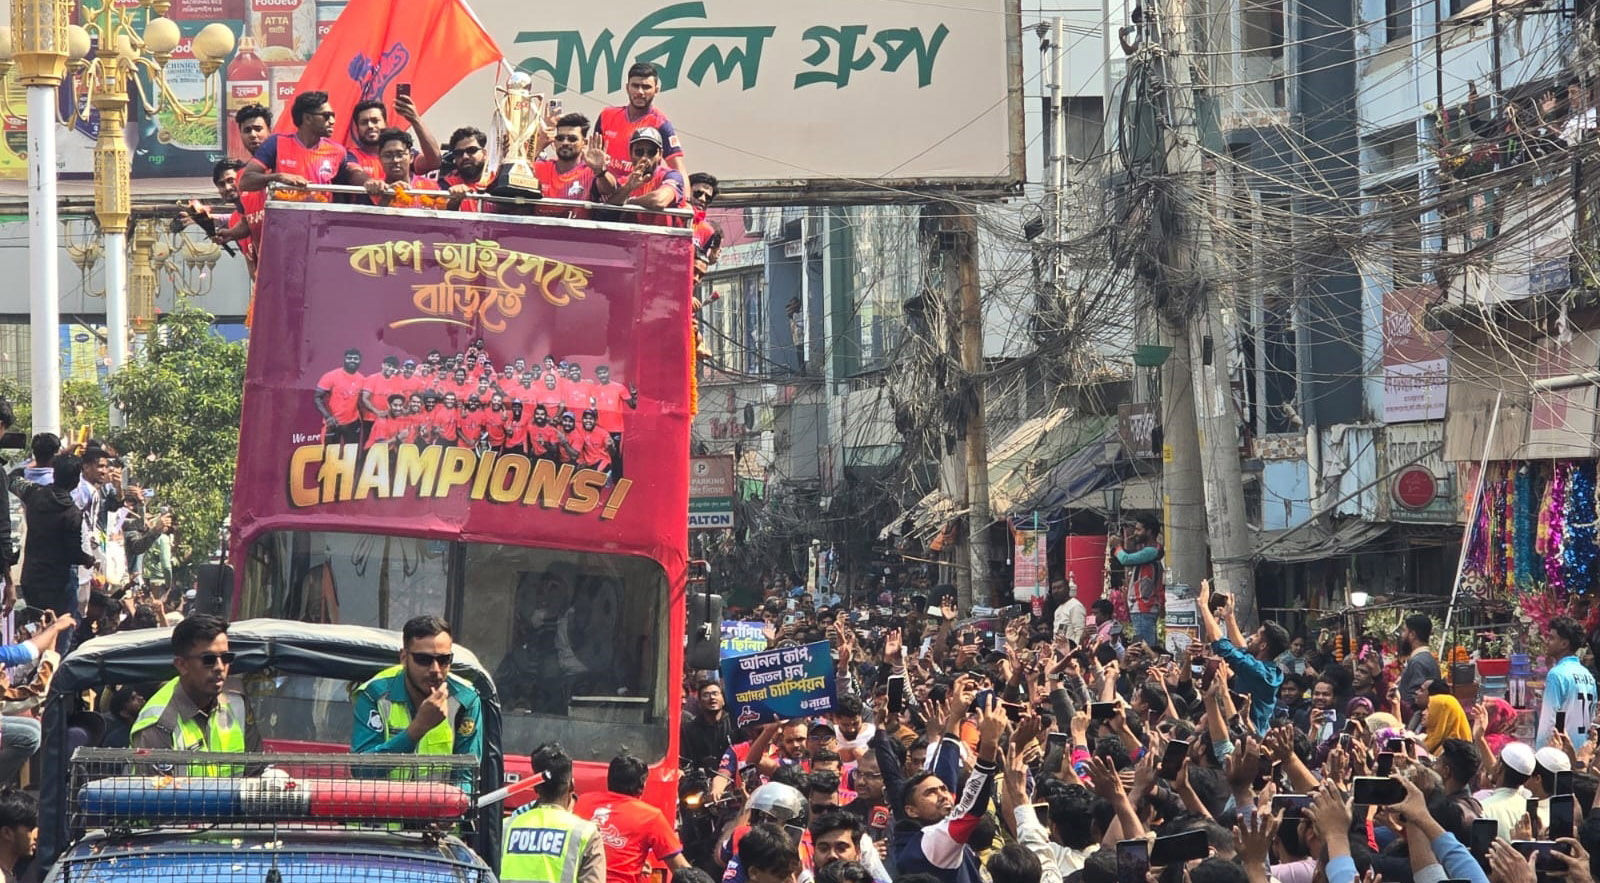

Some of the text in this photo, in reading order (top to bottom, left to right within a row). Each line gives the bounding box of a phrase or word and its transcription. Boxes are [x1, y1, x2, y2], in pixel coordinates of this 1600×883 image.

[264, 16, 289, 25] ATTA
[513, 1, 949, 96] নাবিল গ্রুপ
[346, 238, 593, 306] কাপ আইসেছে
[410, 271, 526, 333] বাড়িতে
[292, 433, 321, 444] We are
[289, 443, 632, 520] CHAMPIONS!
[688, 514, 730, 525] ALTON
[739, 646, 813, 671] আনল কাপ,
[749, 669, 783, 686] জিতল
[736, 687, 768, 703] আমরা
[508, 829, 567, 856] POLICE
